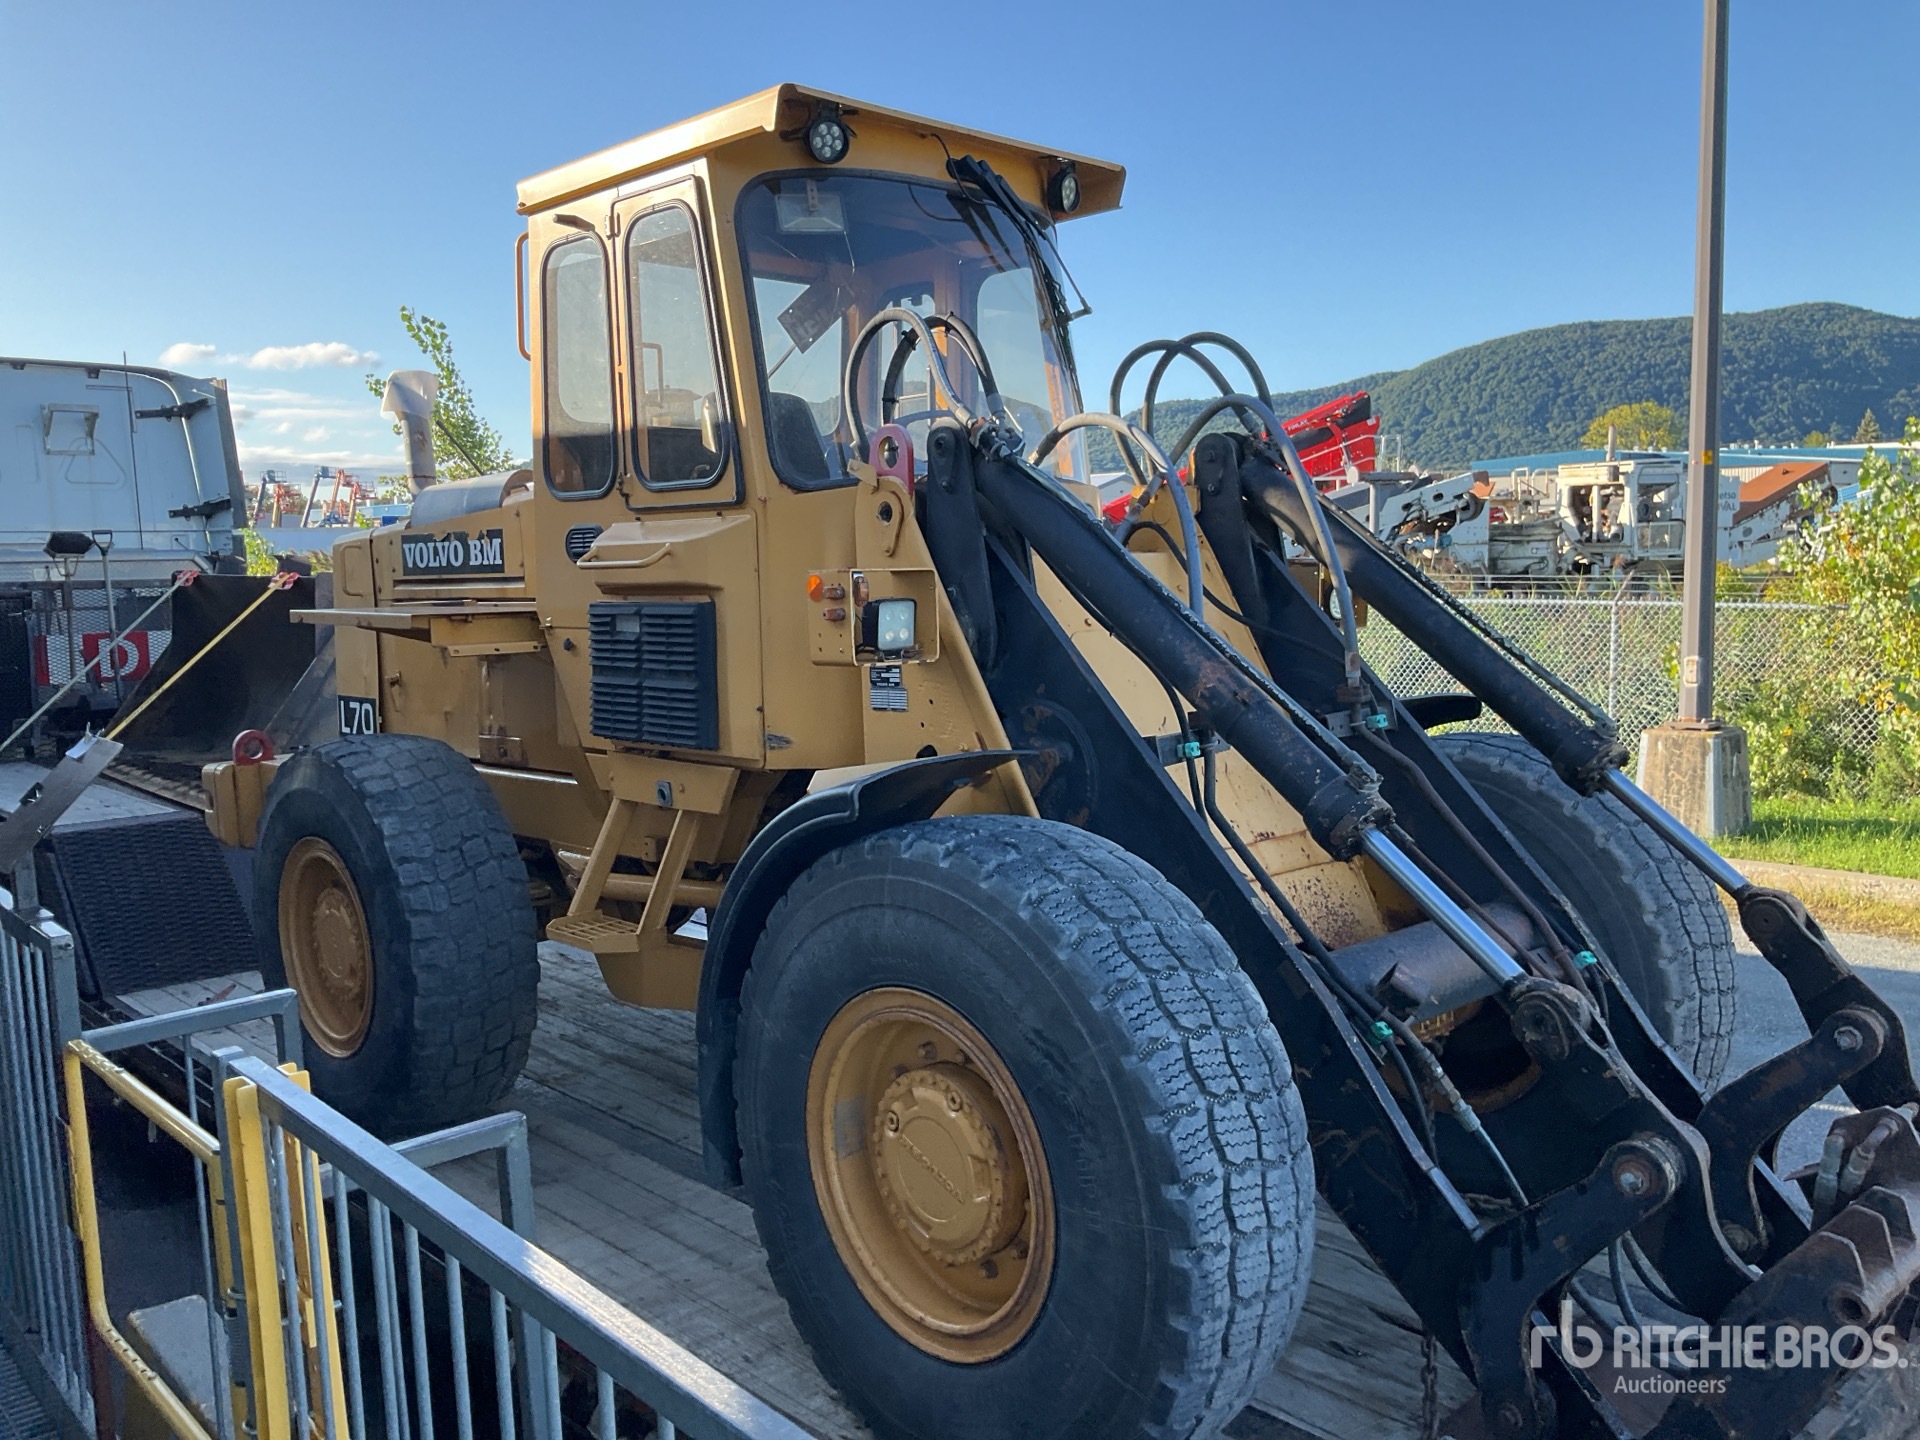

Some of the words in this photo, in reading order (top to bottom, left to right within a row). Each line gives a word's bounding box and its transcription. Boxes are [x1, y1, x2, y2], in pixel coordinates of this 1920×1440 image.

[1719, 491, 1736, 500] etso
[402, 540, 464, 569] VOLVO
[468, 537, 503, 566] BM
[340, 700, 374, 735] L70
